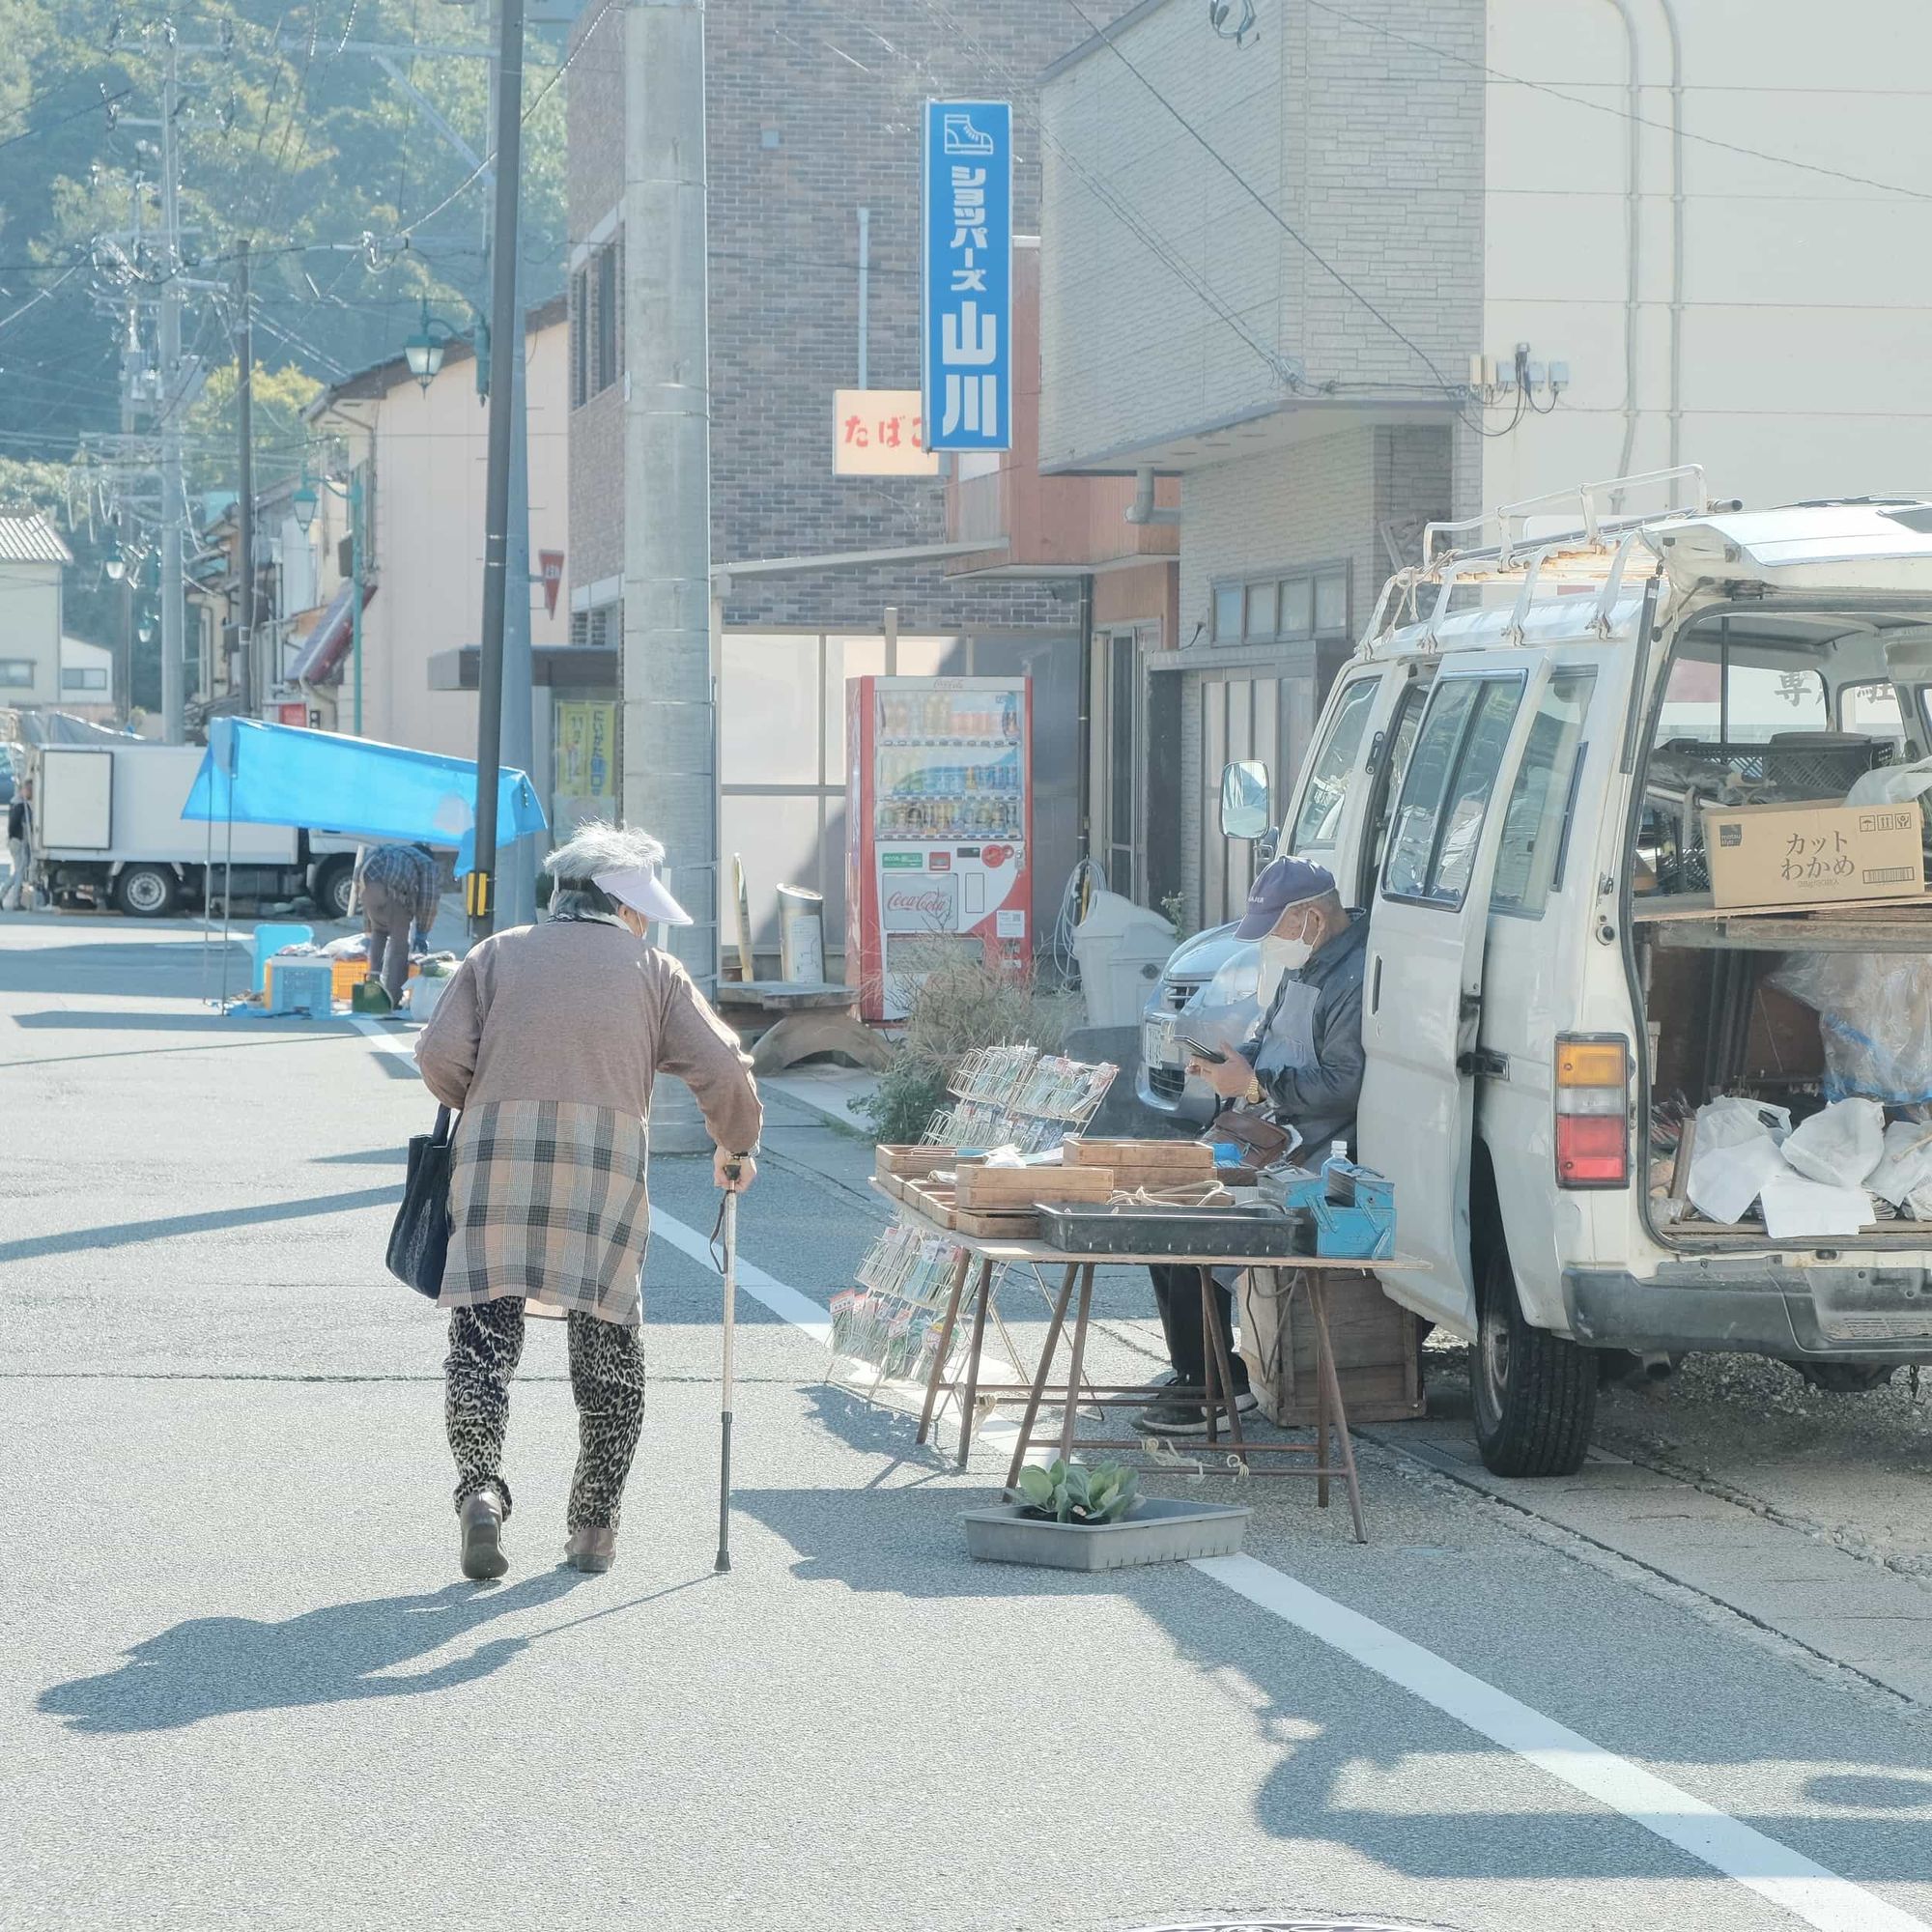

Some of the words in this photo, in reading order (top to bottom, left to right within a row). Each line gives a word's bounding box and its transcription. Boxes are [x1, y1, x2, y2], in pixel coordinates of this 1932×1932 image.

[942, 300, 997, 438] 山川
[1786, 830, 1848, 857] カット
[1780, 855, 1855, 881] わかめ
